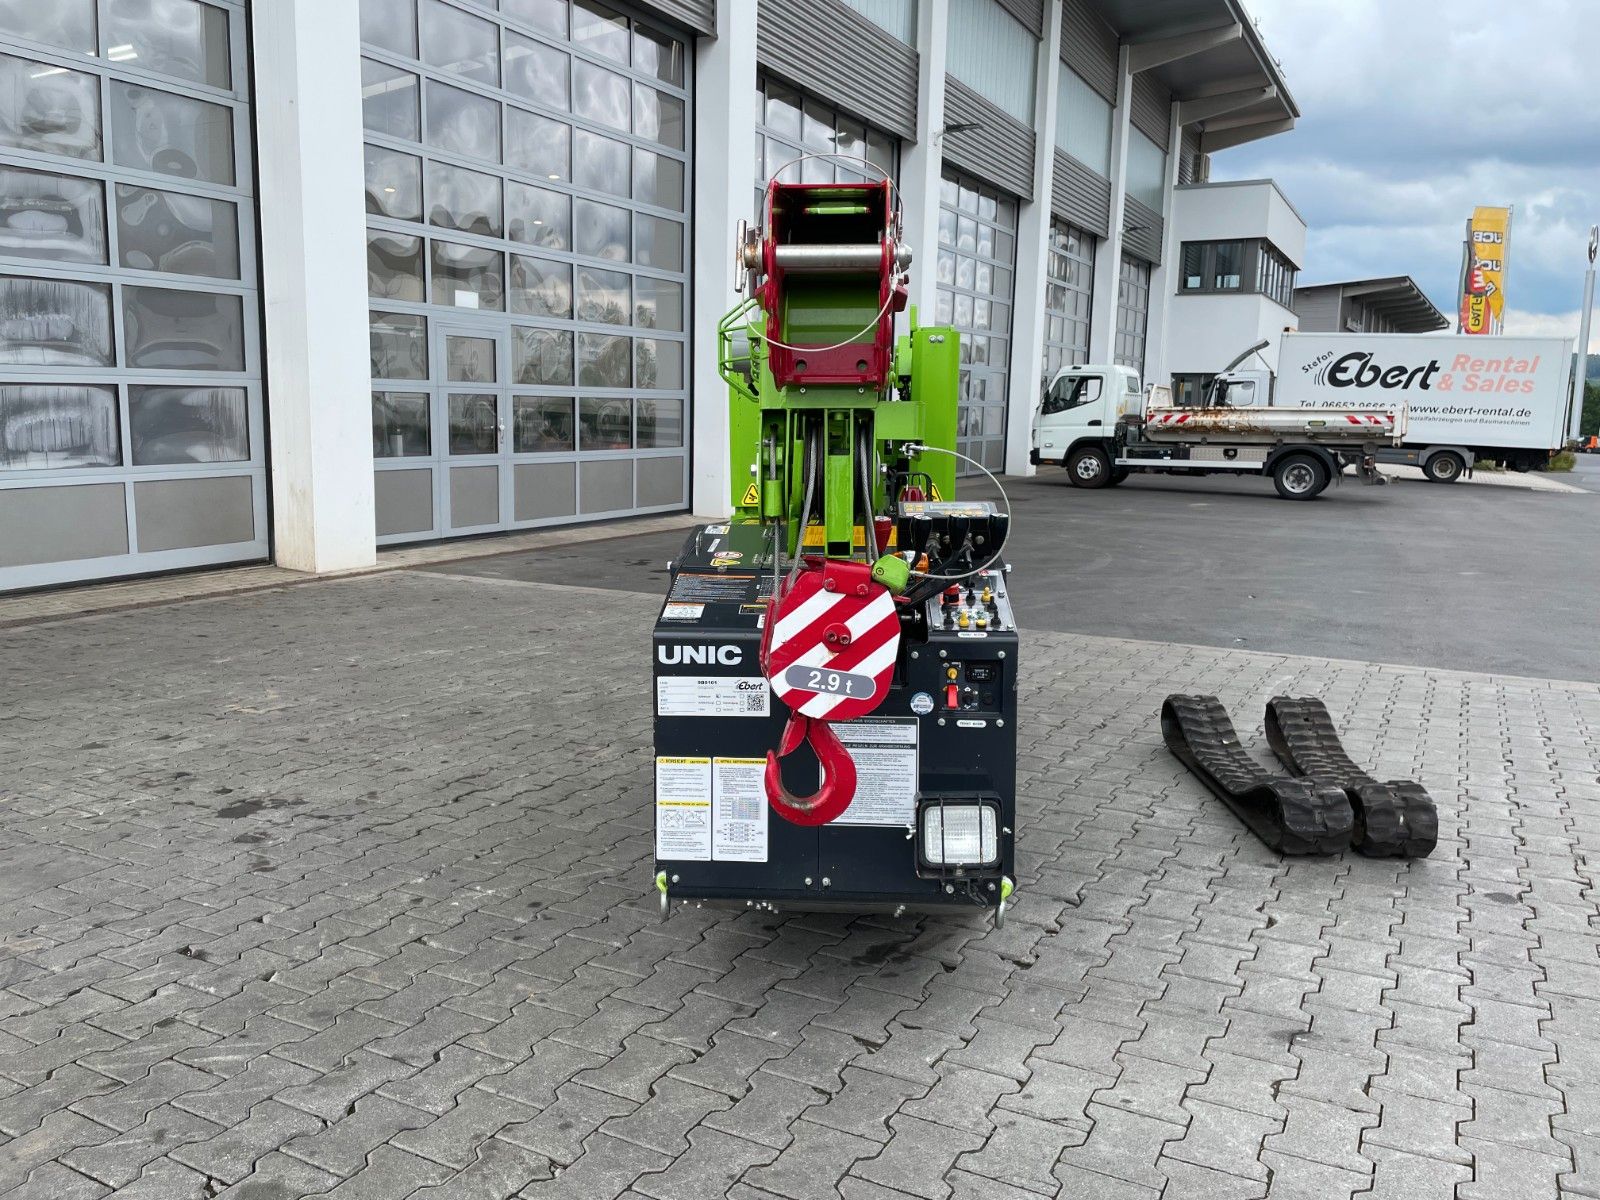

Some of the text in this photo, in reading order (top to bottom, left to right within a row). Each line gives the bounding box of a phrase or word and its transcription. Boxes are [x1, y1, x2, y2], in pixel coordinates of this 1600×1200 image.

[1302, 350, 1333, 373] Stefan
[1326, 351, 1440, 390] Ebert
[1451, 353, 1541, 373] Rental
[1436, 374, 1535, 393] & Sales
[1409, 405, 1531, 418] www.ebert-rental.de
[658, 645, 743, 664] UNIC
[738, 680, 763, 691] Ebert
[808, 671, 852, 693] 2.9 t
